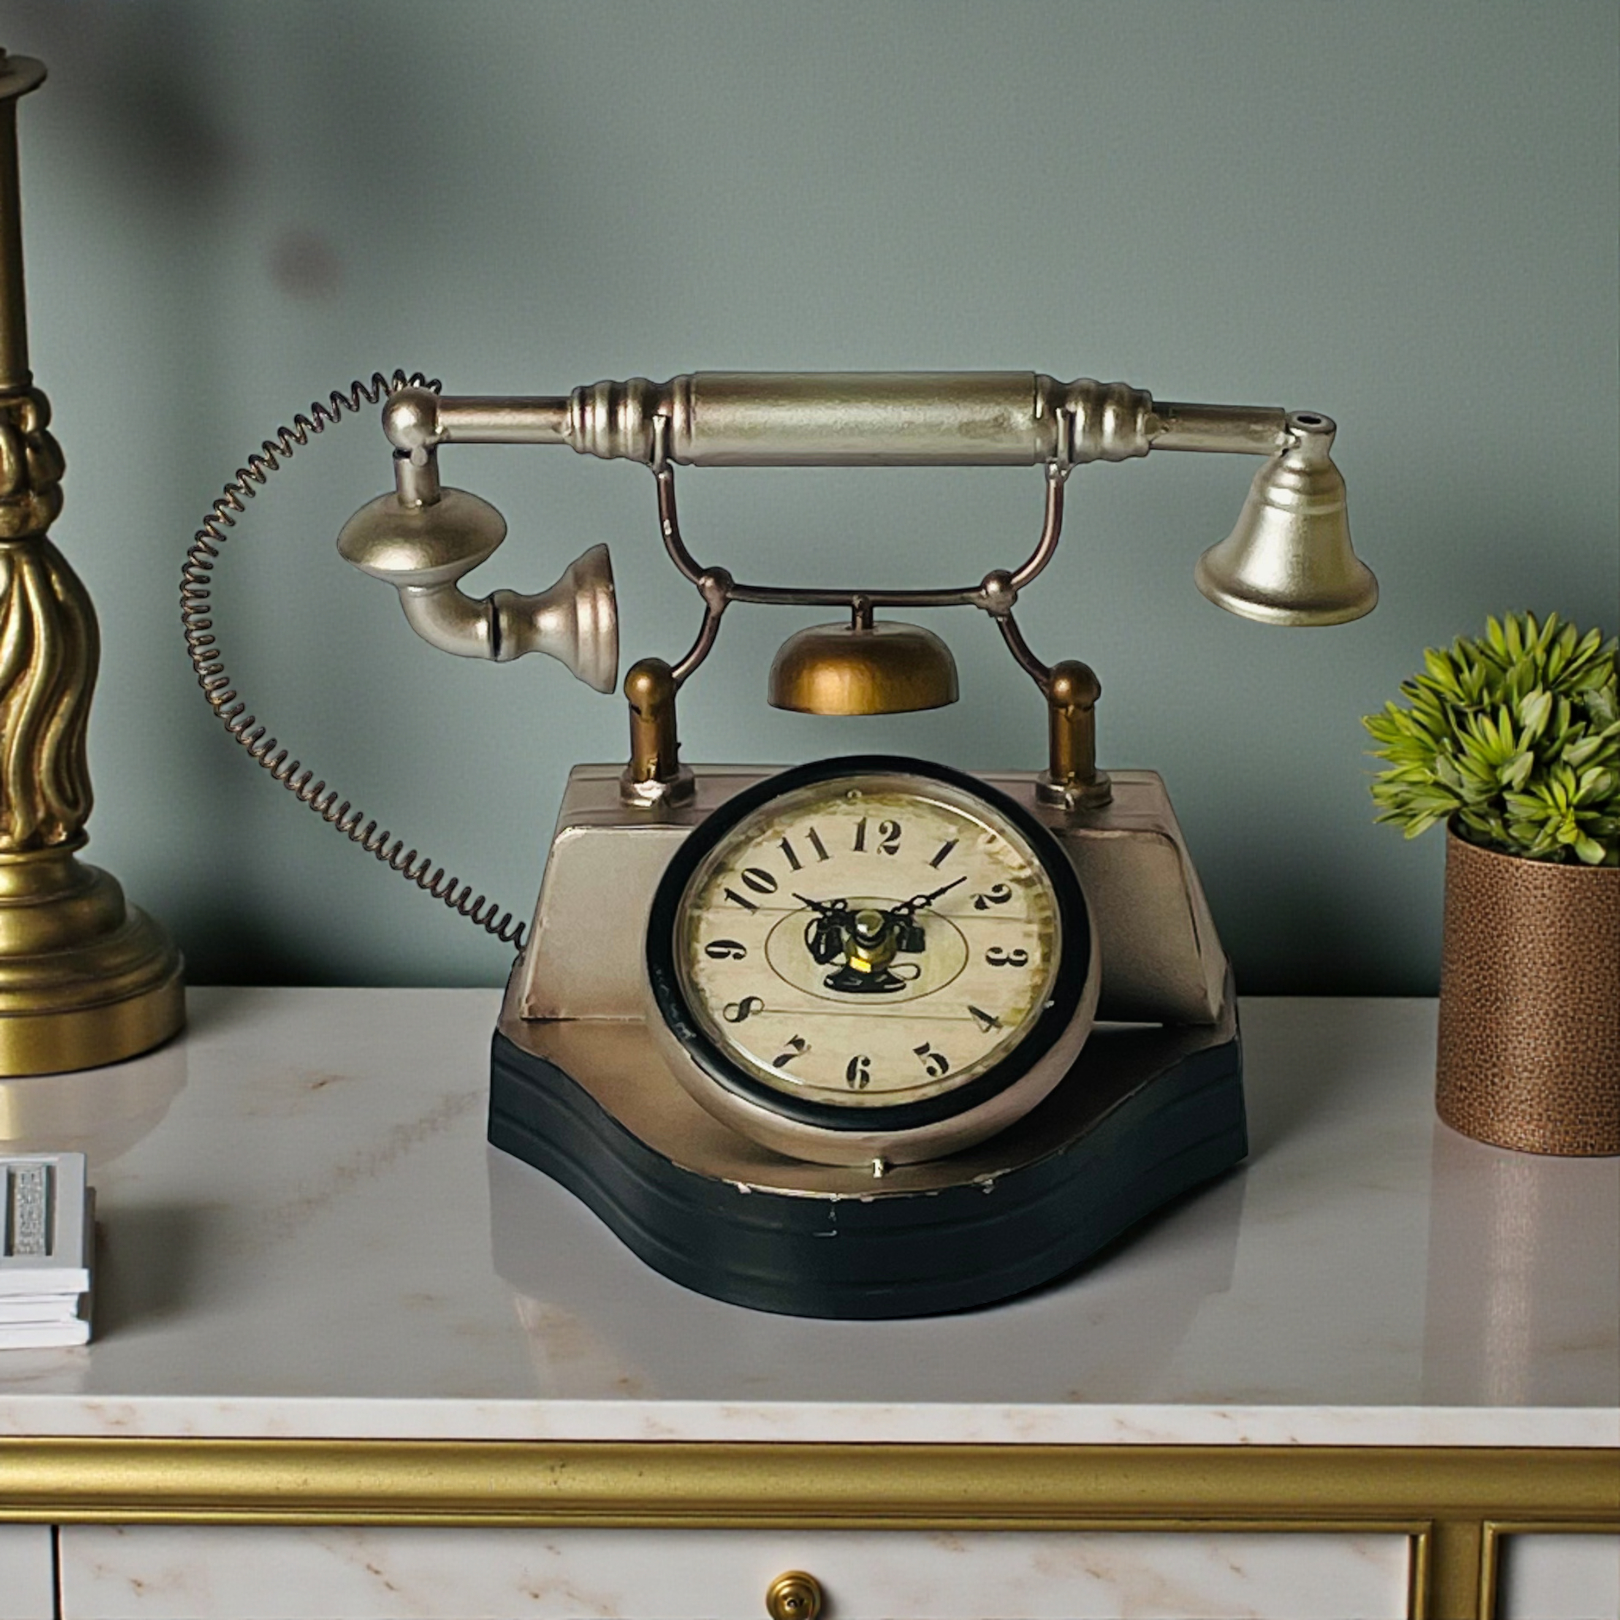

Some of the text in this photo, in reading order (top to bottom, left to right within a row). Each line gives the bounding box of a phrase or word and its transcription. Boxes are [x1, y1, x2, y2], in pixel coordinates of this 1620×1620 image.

[778, 826, 831, 872] 11
[851, 816, 902, 855] 12
[928, 838, 960, 870] 1
[724, 867, 778, 915] 10
[973, 882, 1013, 911] 2
[704, 939, 747, 961] 9
[985, 946, 1029, 968] 3
[722, 995, 765, 1023] 8
[967, 1005, 1003, 1034] 4
[772, 1033, 812, 1068] 7
[913, 1042, 950, 1078] 5
[845, 1054, 872, 1089] 6
